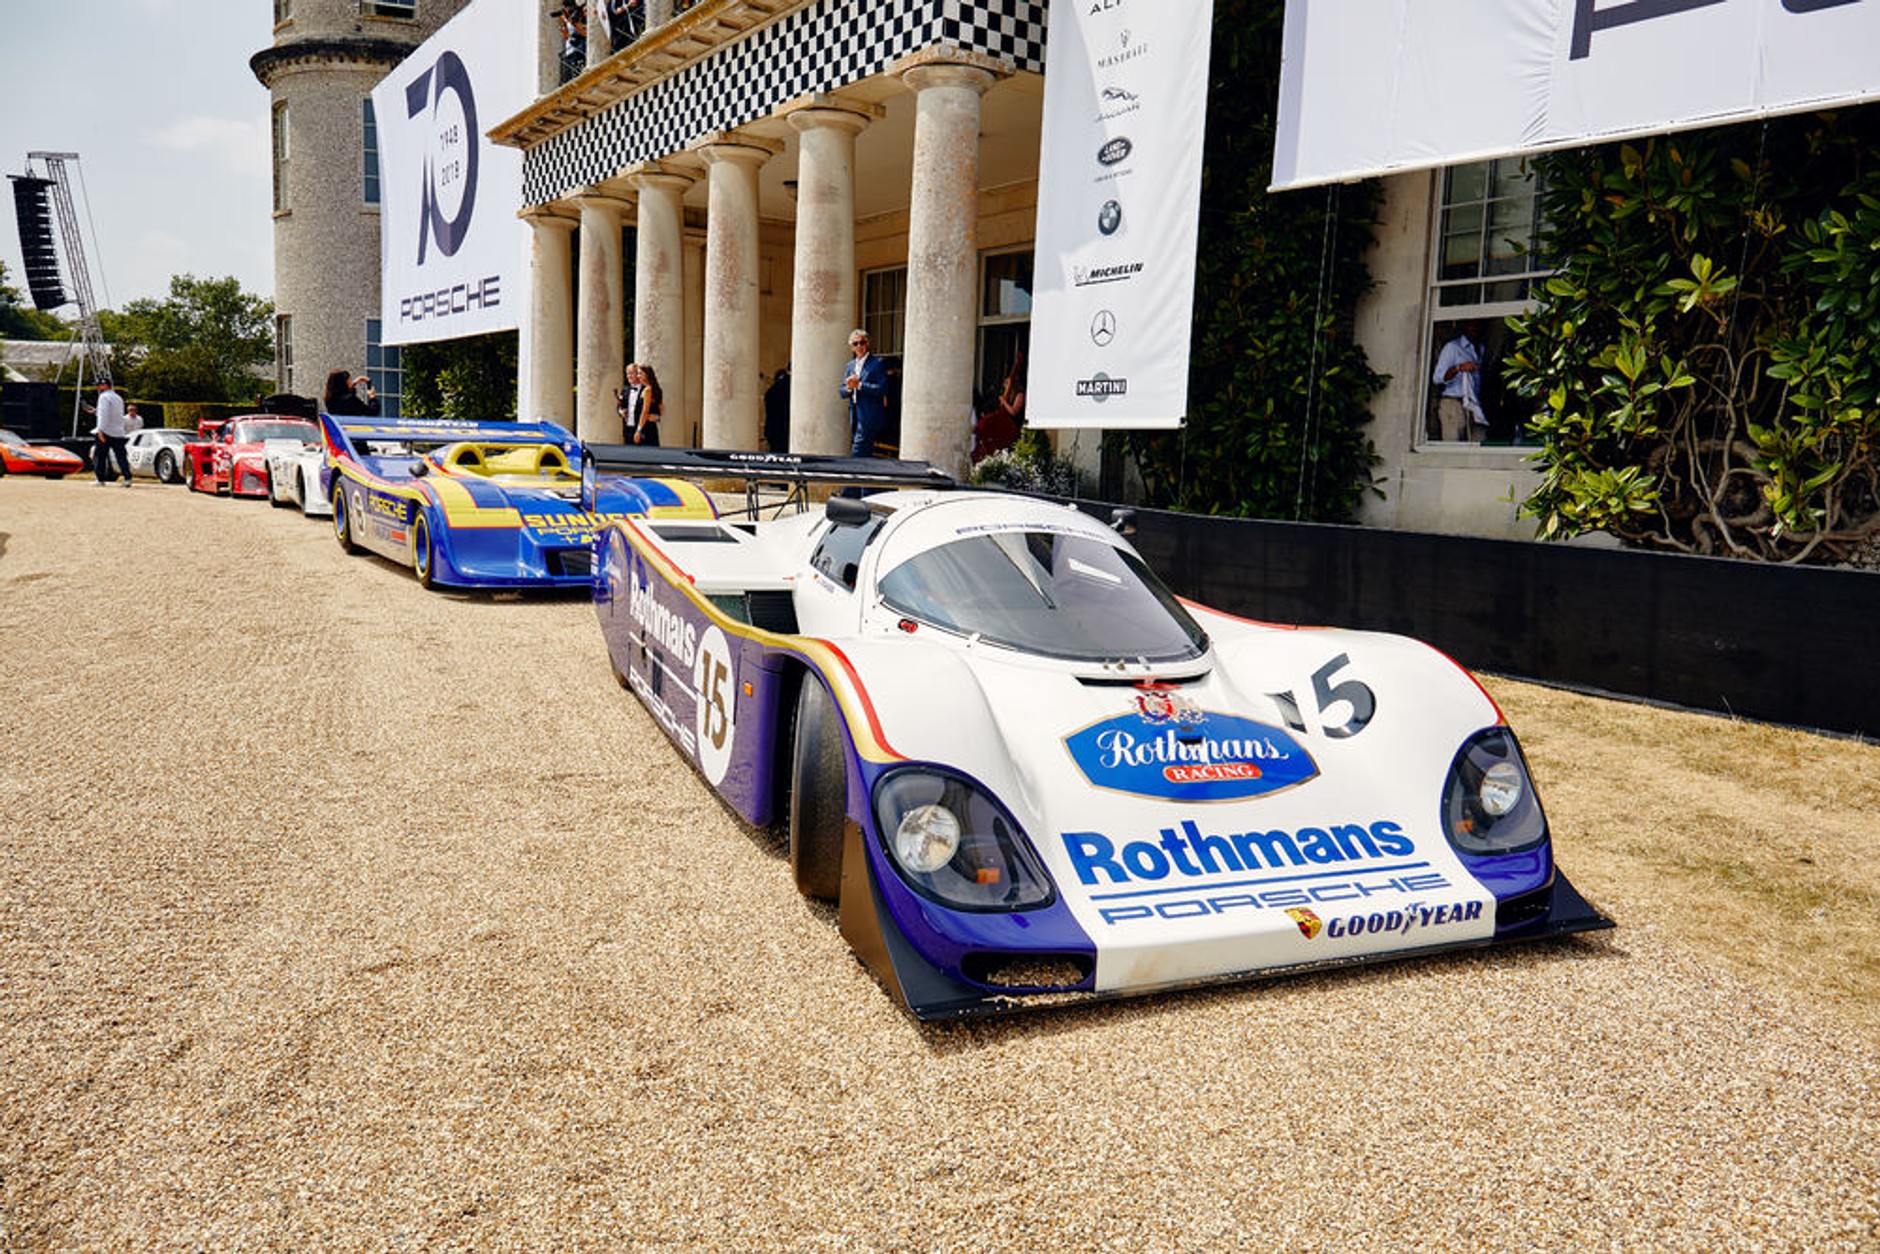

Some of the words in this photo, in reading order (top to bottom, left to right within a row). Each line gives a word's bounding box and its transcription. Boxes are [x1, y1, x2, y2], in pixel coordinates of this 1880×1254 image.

[441, 160, 460, 186] 2018
[1089, 262, 1144, 279] MICHELIN
[401, 275, 501, 322] PORSCHE
[1078, 381, 1126, 394] MARTINI
[368, 494, 408, 521] PORSCHE
[629, 664, 697, 756] PORSCHE
[703, 649, 728, 750] 15
[1264, 652, 1377, 740] 15
[1096, 728, 1289, 768] Rothmans
[1172, 763, 1254, 781] RACING
[1061, 820, 1416, 885] Rothmans
[1099, 873, 1452, 925] PORSCHE
